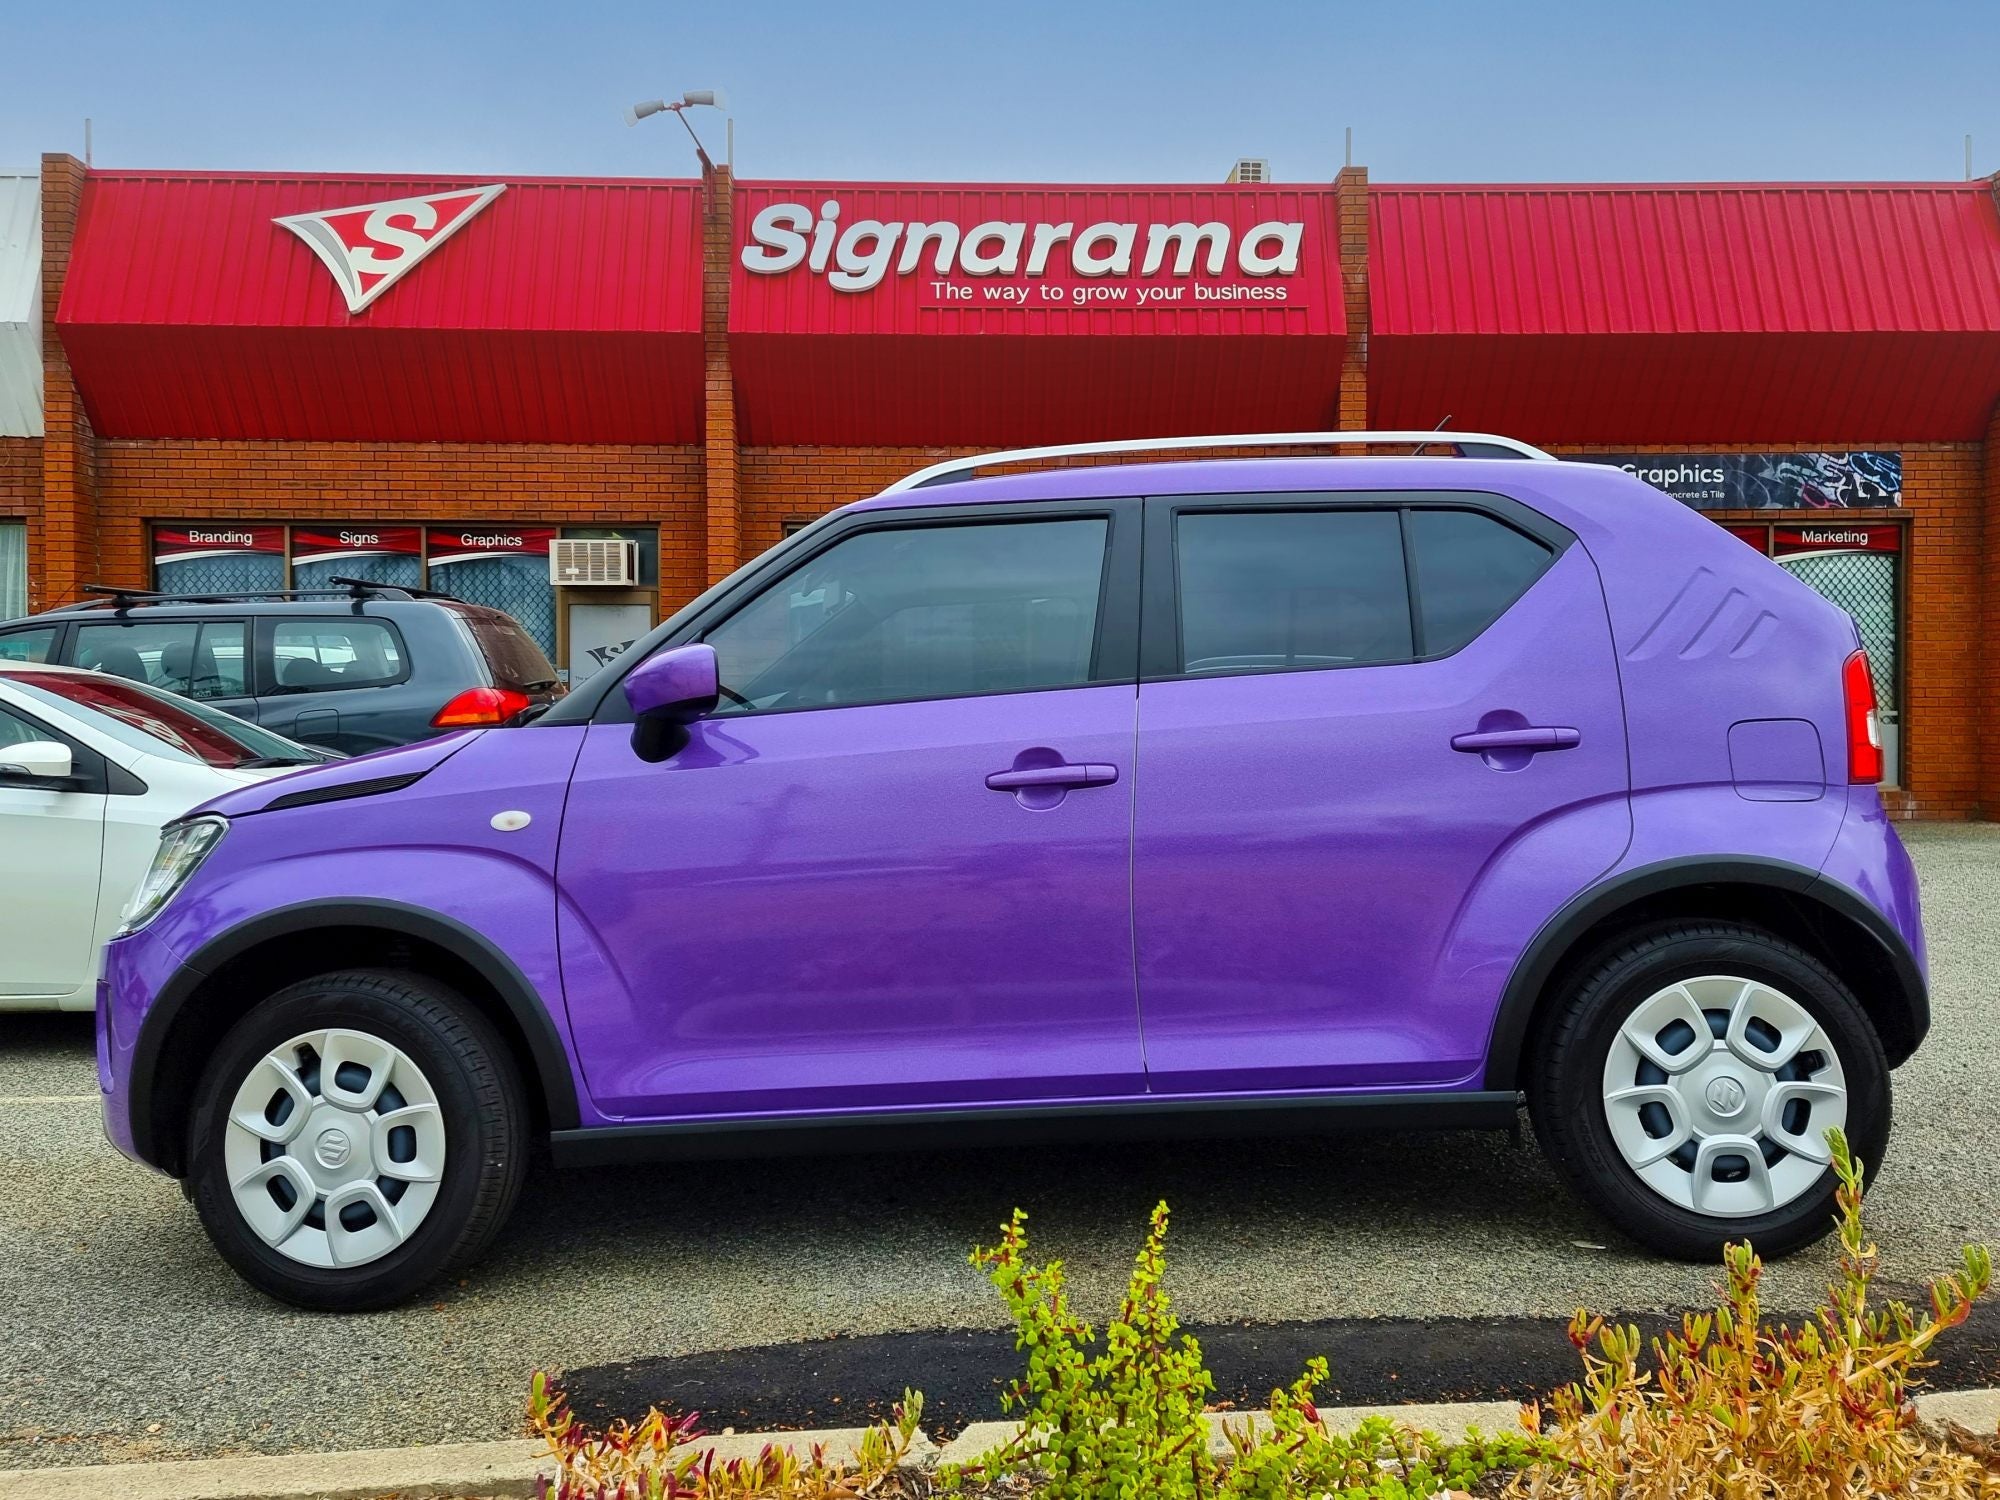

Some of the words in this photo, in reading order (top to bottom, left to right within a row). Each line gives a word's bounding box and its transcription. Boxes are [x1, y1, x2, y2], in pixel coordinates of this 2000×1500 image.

[740, 199, 1305, 293] Signarama
[930, 281, 973, 300] The
[983, 286, 1030, 305] way
[1039, 284, 1064, 300] to
[1072, 286, 1128, 305] grow
[1135, 286, 1186, 305] your
[1194, 282, 1288, 300] business
[1662, 490, 1700, 499] oncrete
[1701, 490, 1709, 499] &
[1710, 490, 1726, 499] Tile
[189, 530, 253, 547] Branding
[339, 531, 379, 547] Signs
[460, 533, 523, 549] Graphics
[1802, 530, 1868, 546] Marketing
